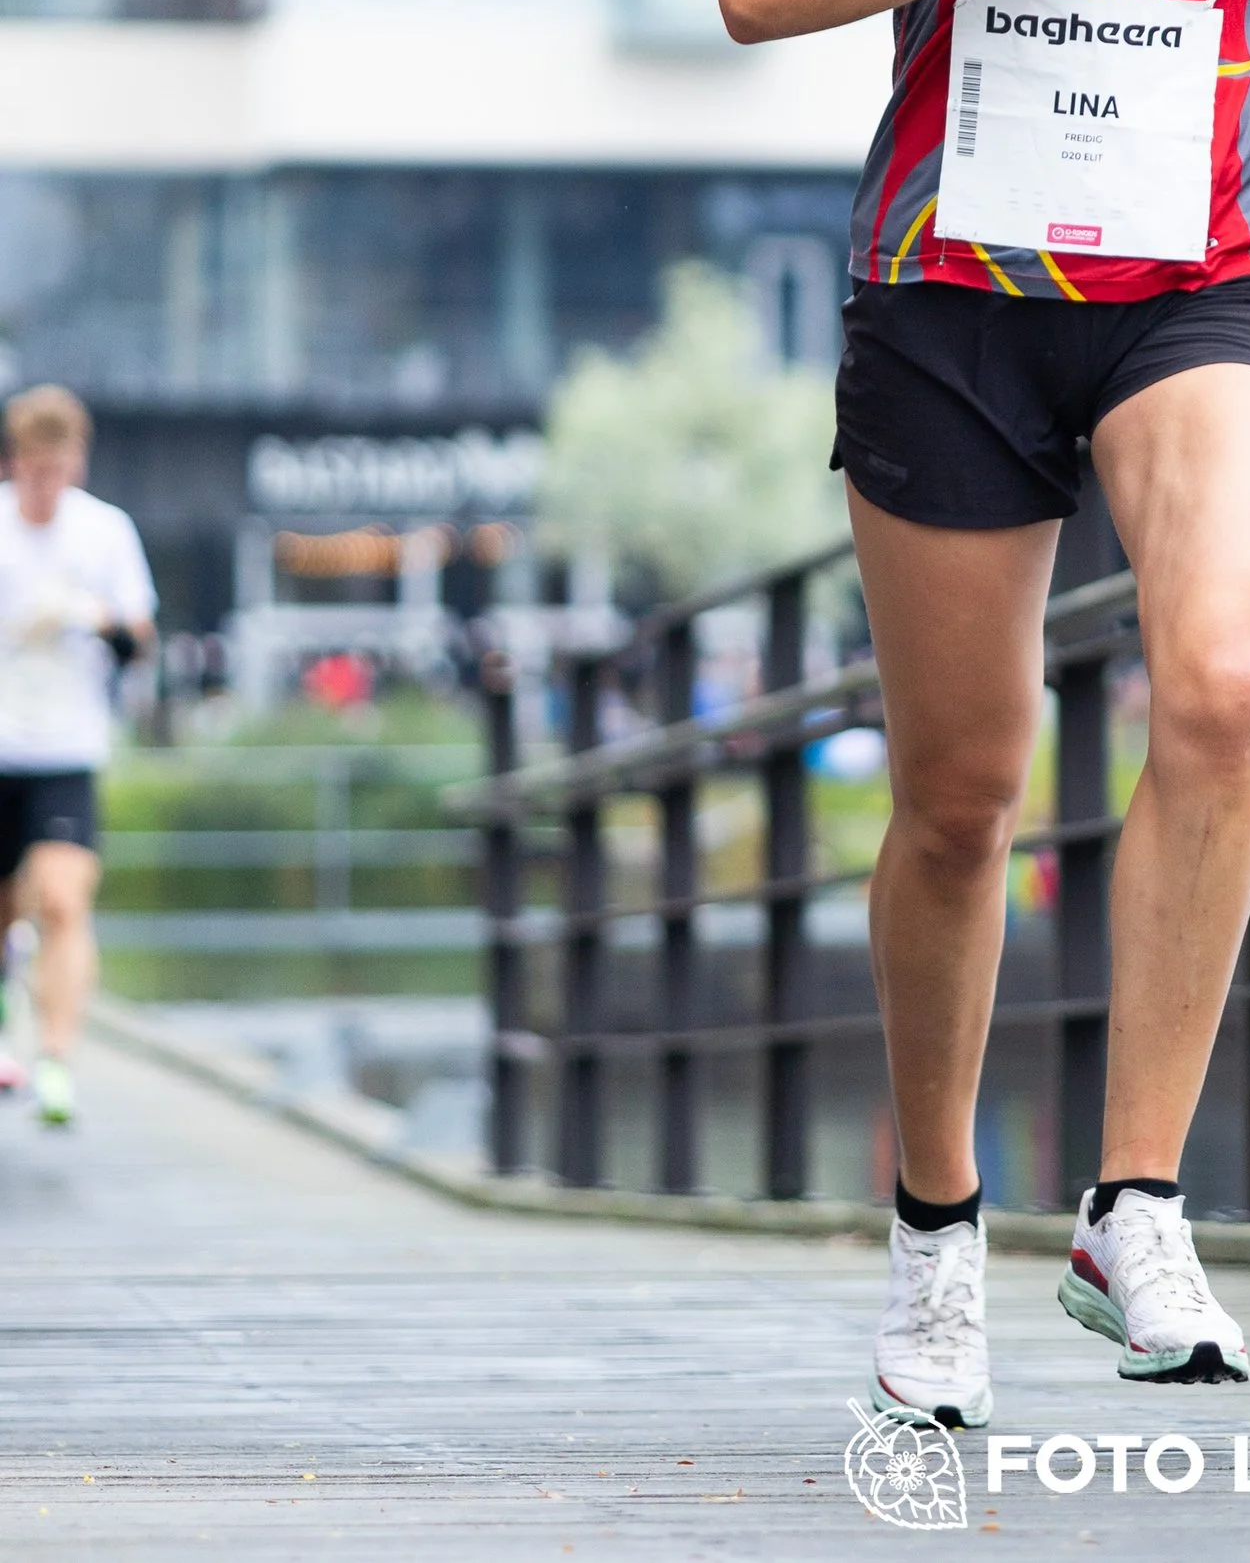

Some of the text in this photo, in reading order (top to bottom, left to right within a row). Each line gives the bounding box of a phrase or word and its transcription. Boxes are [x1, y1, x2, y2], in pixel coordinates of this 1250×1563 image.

[985, 6, 1183, 49] bagheera
[1053, 90, 1120, 119] LINA
[1064, 132, 1103, 144] FREIDIG
[1061, 150, 1103, 162] D20 ELIT
